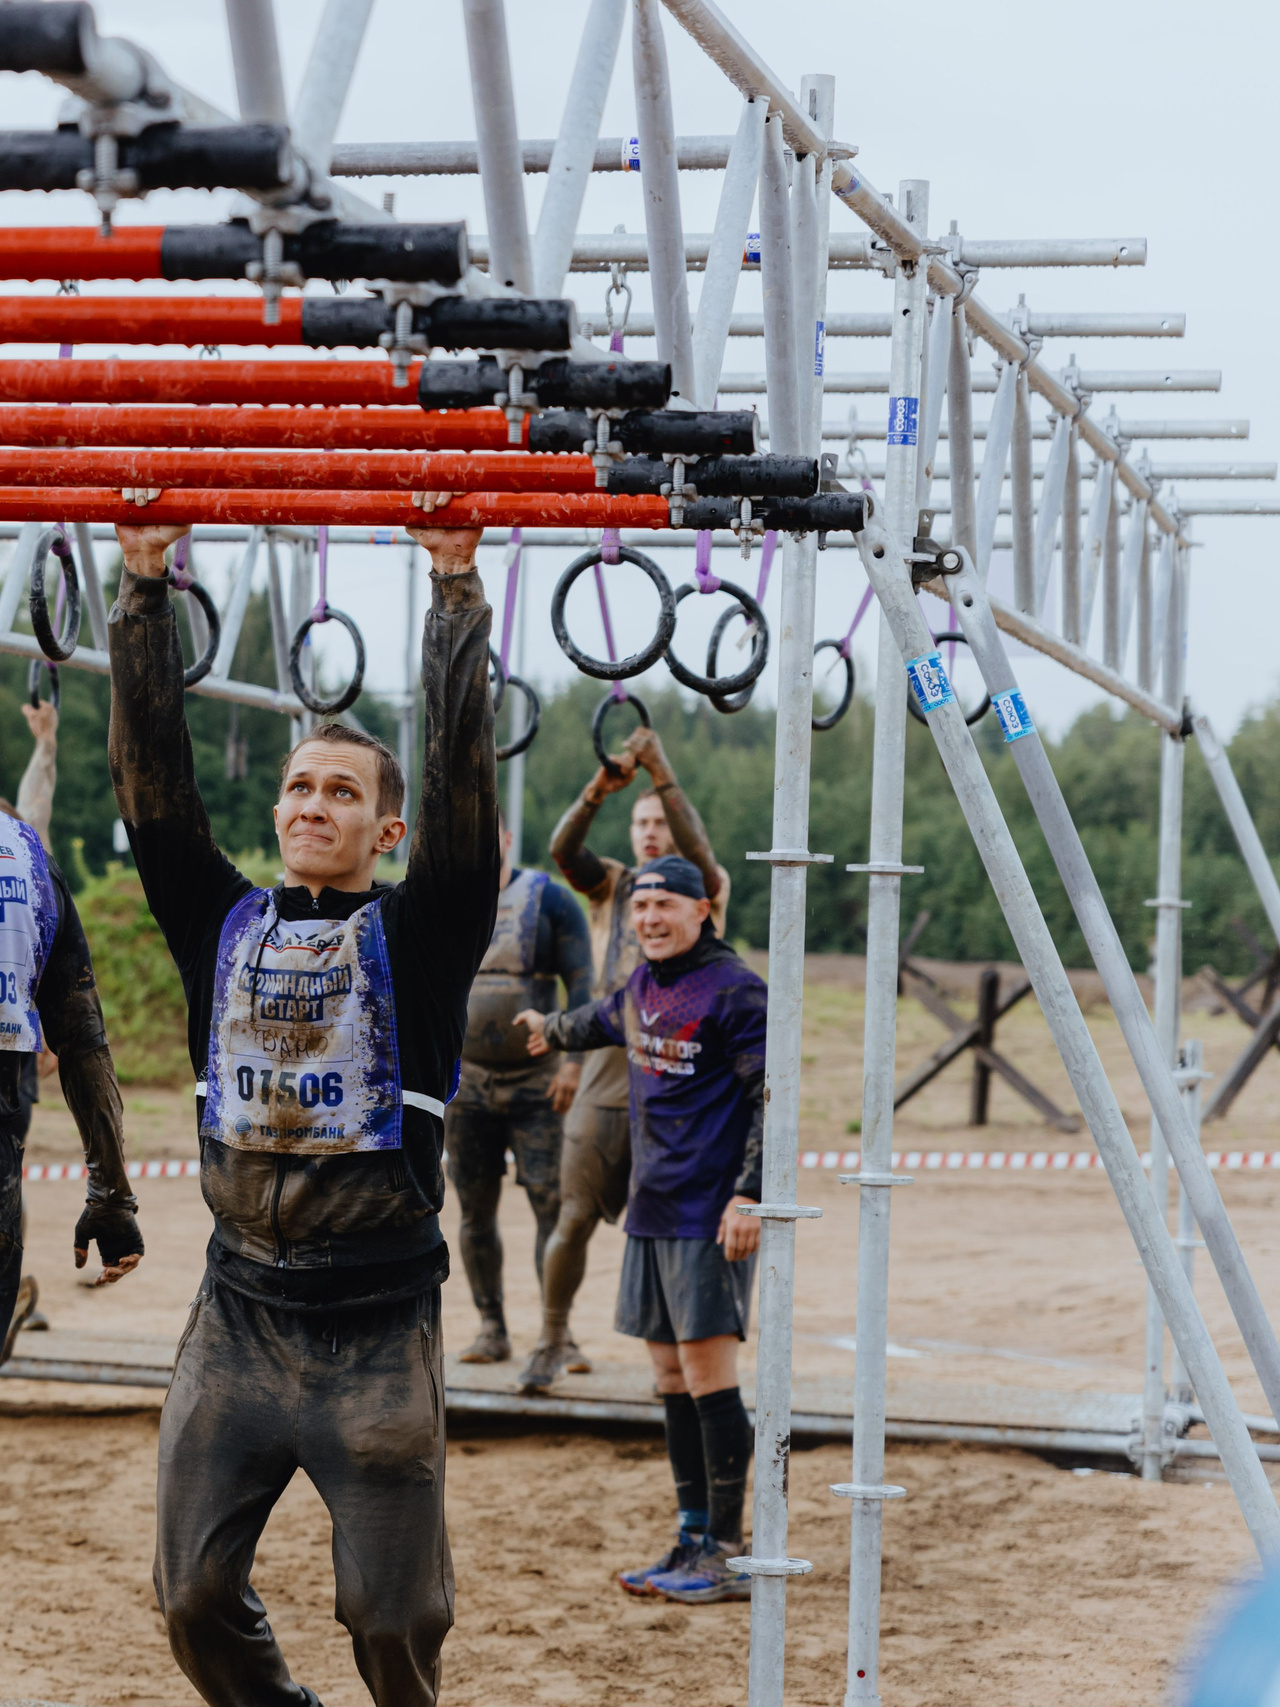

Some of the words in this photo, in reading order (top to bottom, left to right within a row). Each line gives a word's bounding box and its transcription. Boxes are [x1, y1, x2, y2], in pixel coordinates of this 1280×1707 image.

[1003, 699, 1019, 729] СОЮЗ
[239, 963, 351, 999] КОМАНДНЫЙ
[264, 997, 320, 1019] СТАРТ
[236, 1065, 344, 1108] 01506
[260, 1125, 346, 1139] ГАЗПРОМБАНК
